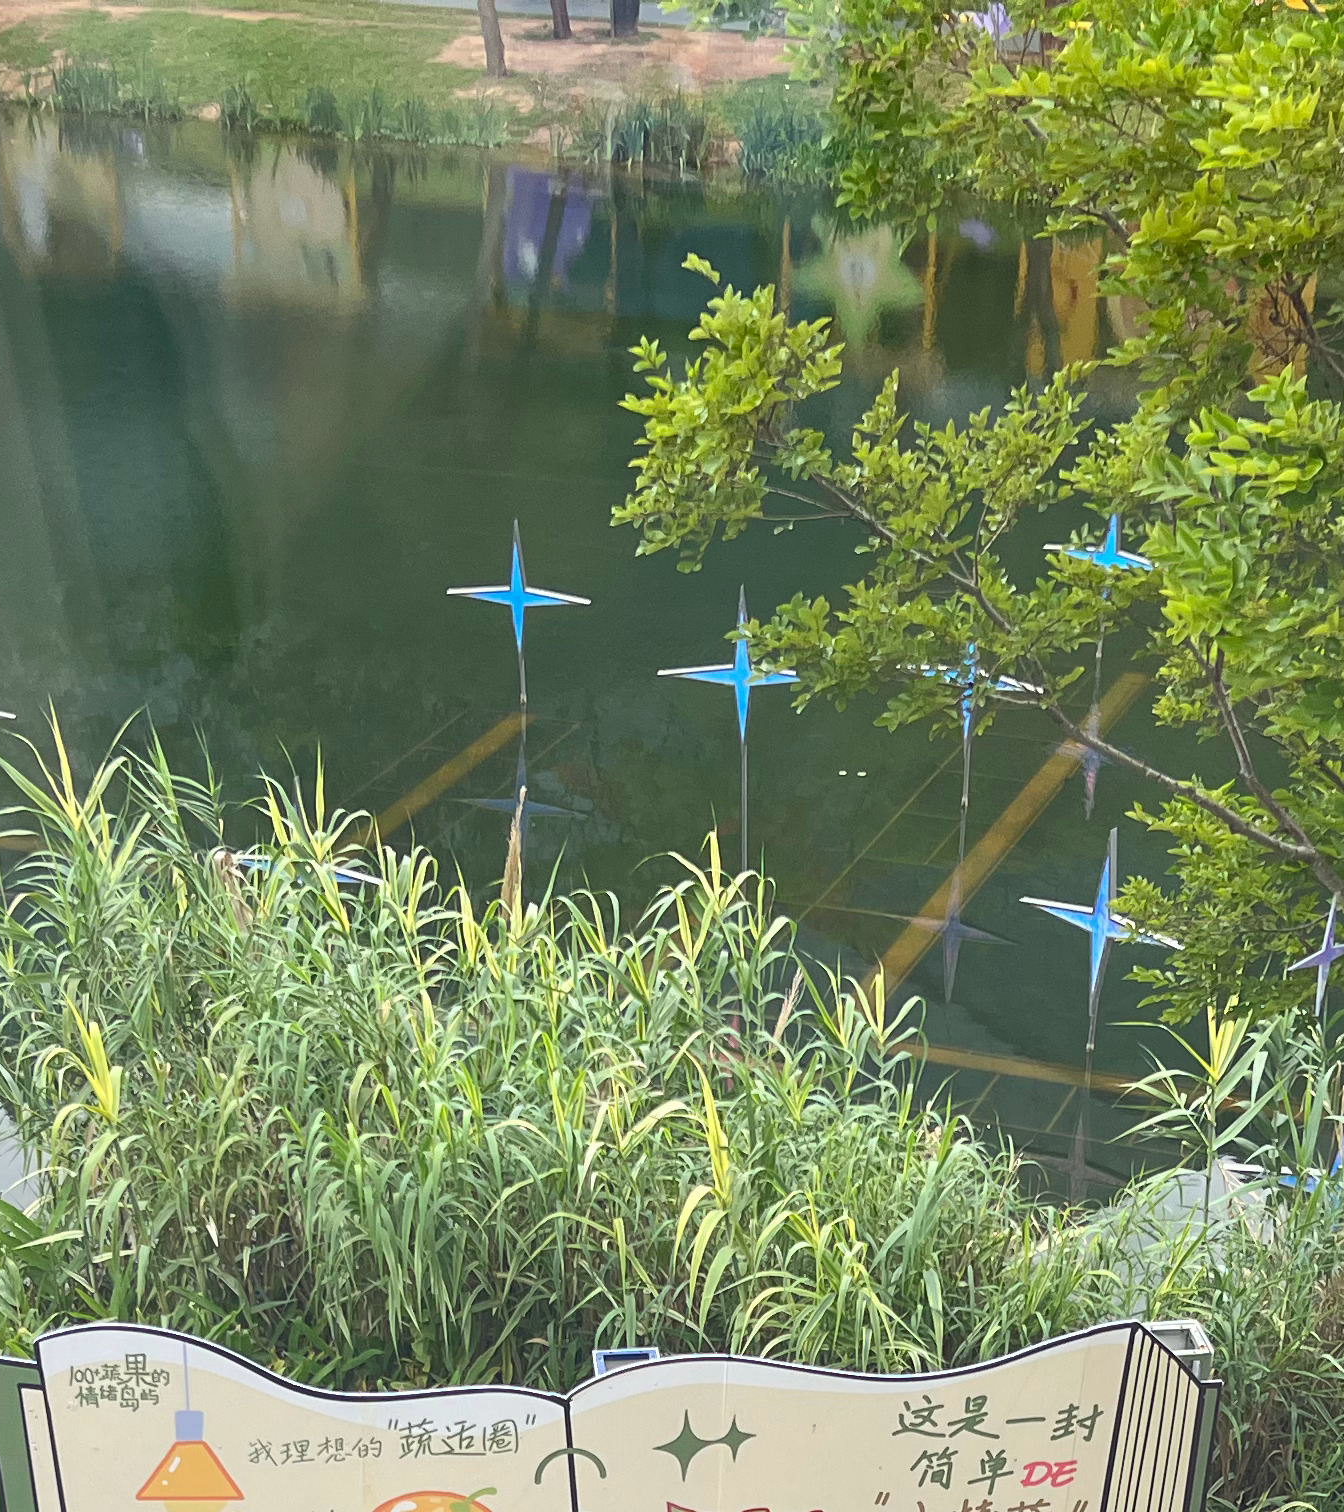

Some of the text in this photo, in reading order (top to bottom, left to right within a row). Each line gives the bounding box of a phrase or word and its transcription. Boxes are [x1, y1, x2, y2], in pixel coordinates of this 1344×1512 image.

[75, 1384, 160, 1412] 情绪岛屿
[891, 1394, 1104, 1441] 这是一封
